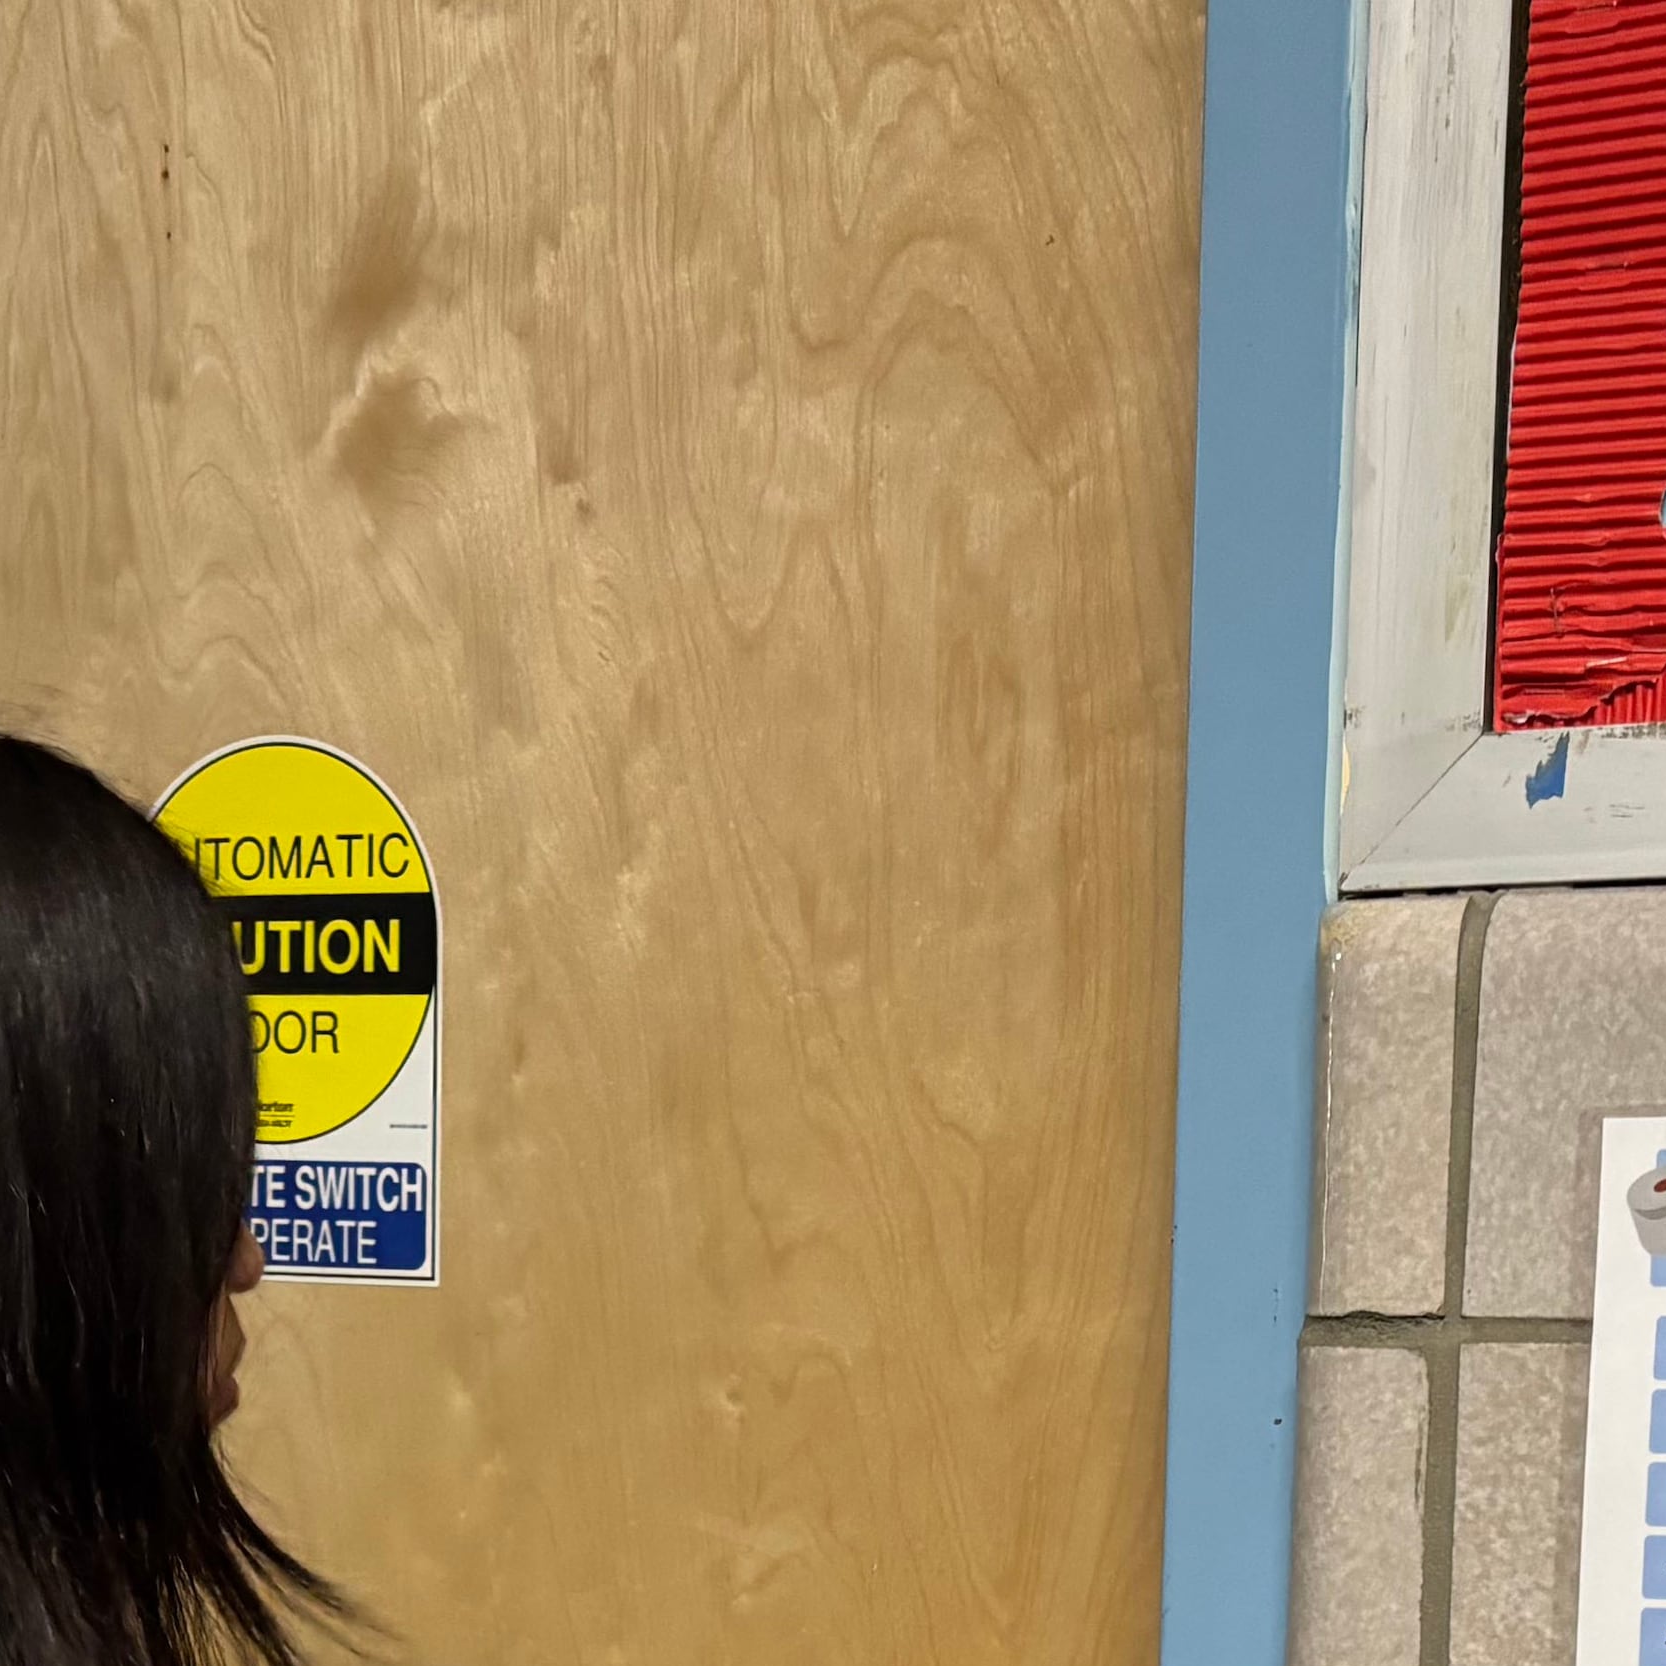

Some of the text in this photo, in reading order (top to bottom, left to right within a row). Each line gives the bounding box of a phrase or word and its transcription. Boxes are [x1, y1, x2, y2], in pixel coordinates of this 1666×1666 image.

[195, 832, 409, 881] TOMATIC
[232, 919, 400, 975] UTION
[248, 1010, 339, 1054] OOR
[295, 1165, 422, 1212] SWITCH
[250, 1218, 377, 1264] PERATE
